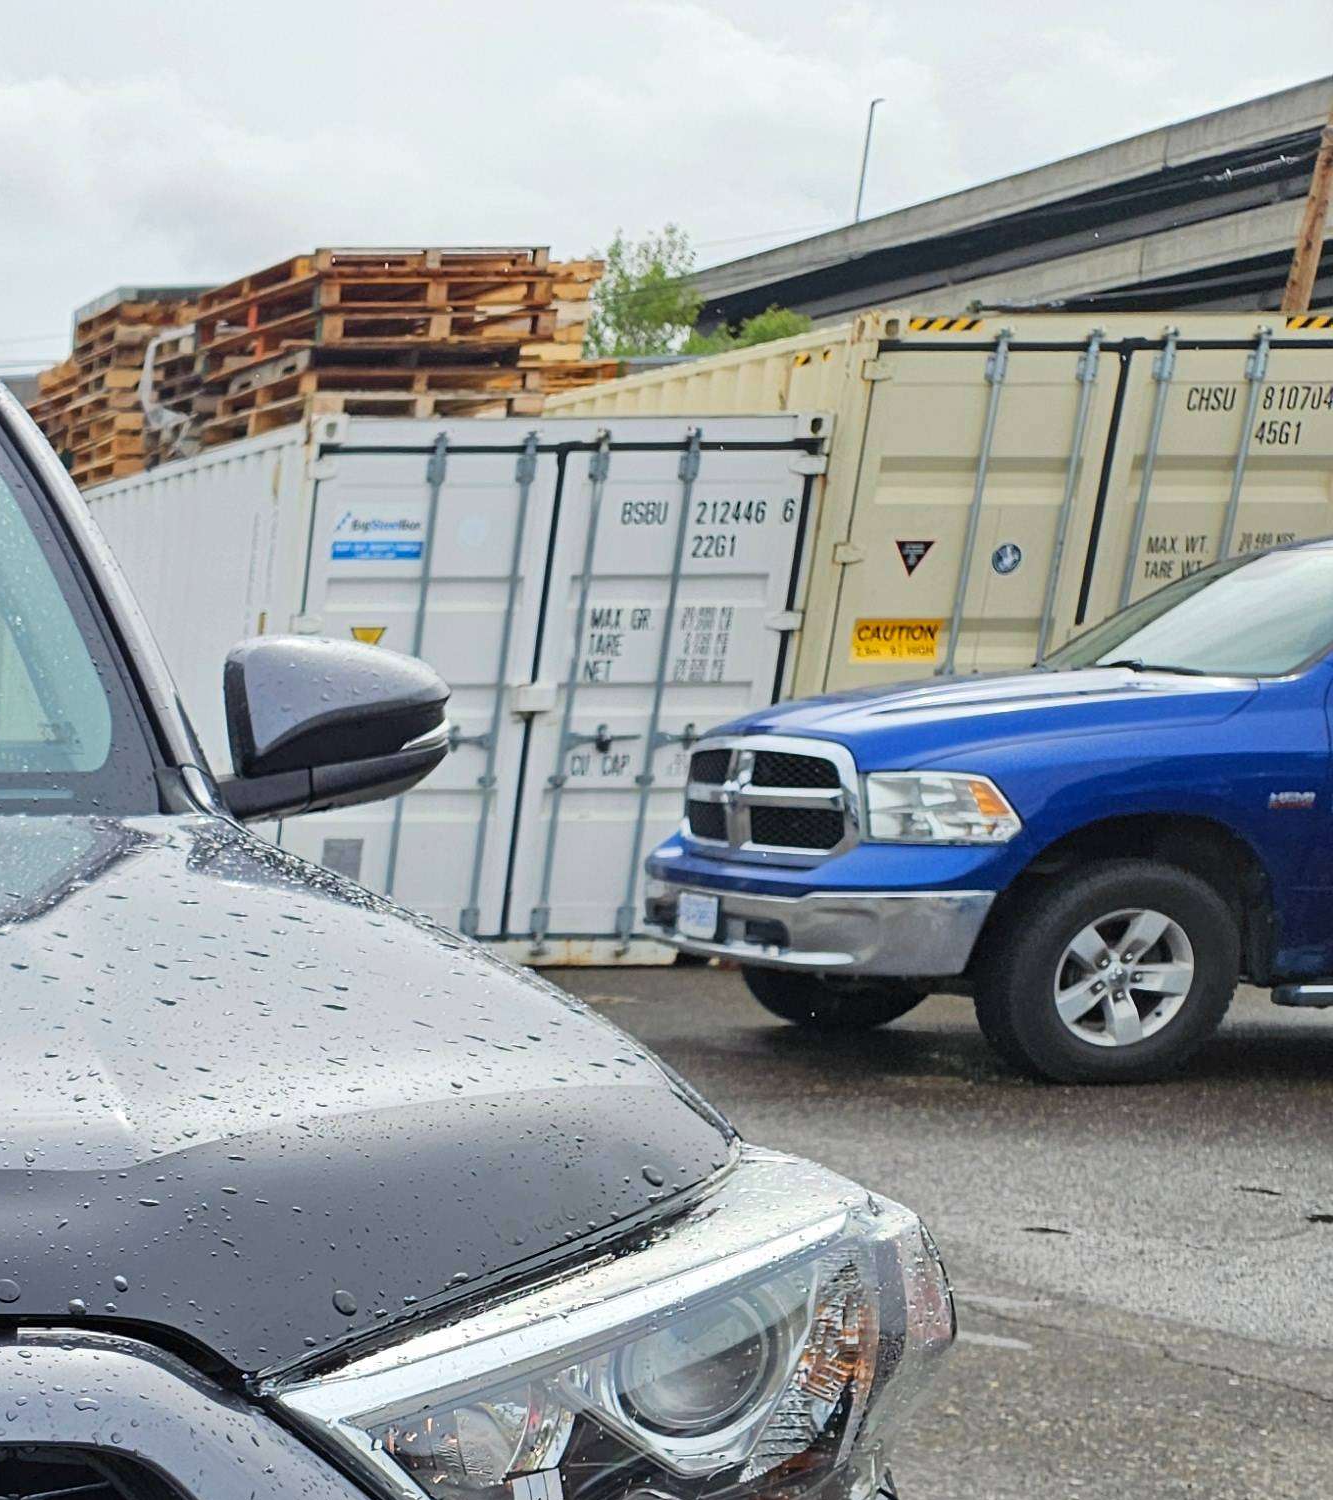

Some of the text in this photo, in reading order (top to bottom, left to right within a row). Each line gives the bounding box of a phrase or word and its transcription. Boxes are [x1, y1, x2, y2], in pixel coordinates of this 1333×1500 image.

[1187, 385, 1333, 412] CHSU 810704
[1254, 420, 1302, 445] 45G1
[621, 498, 797, 526] BSBU 212446 6
[691, 534, 737, 558] 22G1
[857, 623, 939, 642] CAUTION
[589, 634, 624, 657] TARE
[584, 659, 613, 683] NET
